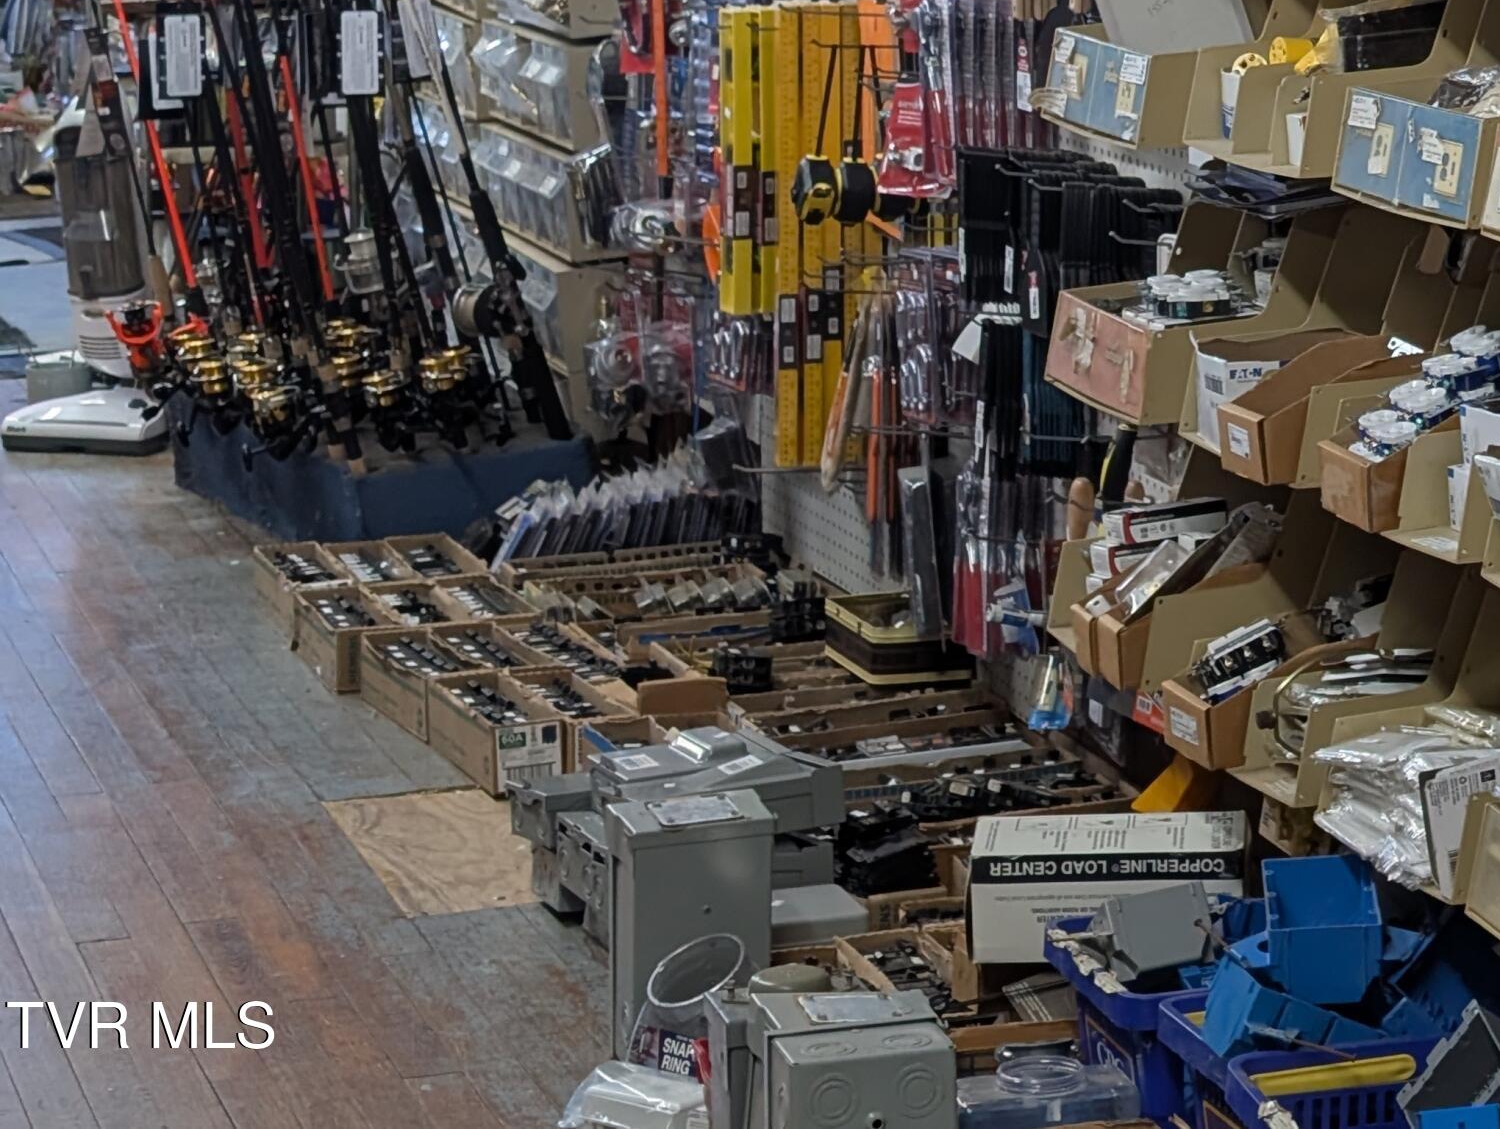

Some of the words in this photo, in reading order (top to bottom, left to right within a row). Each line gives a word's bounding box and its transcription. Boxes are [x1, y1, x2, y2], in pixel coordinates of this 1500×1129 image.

[989, 860, 1057, 877] CENTER
[1061, 859, 1108, 875] LOAD
[661, 1054, 691, 1075] RING
